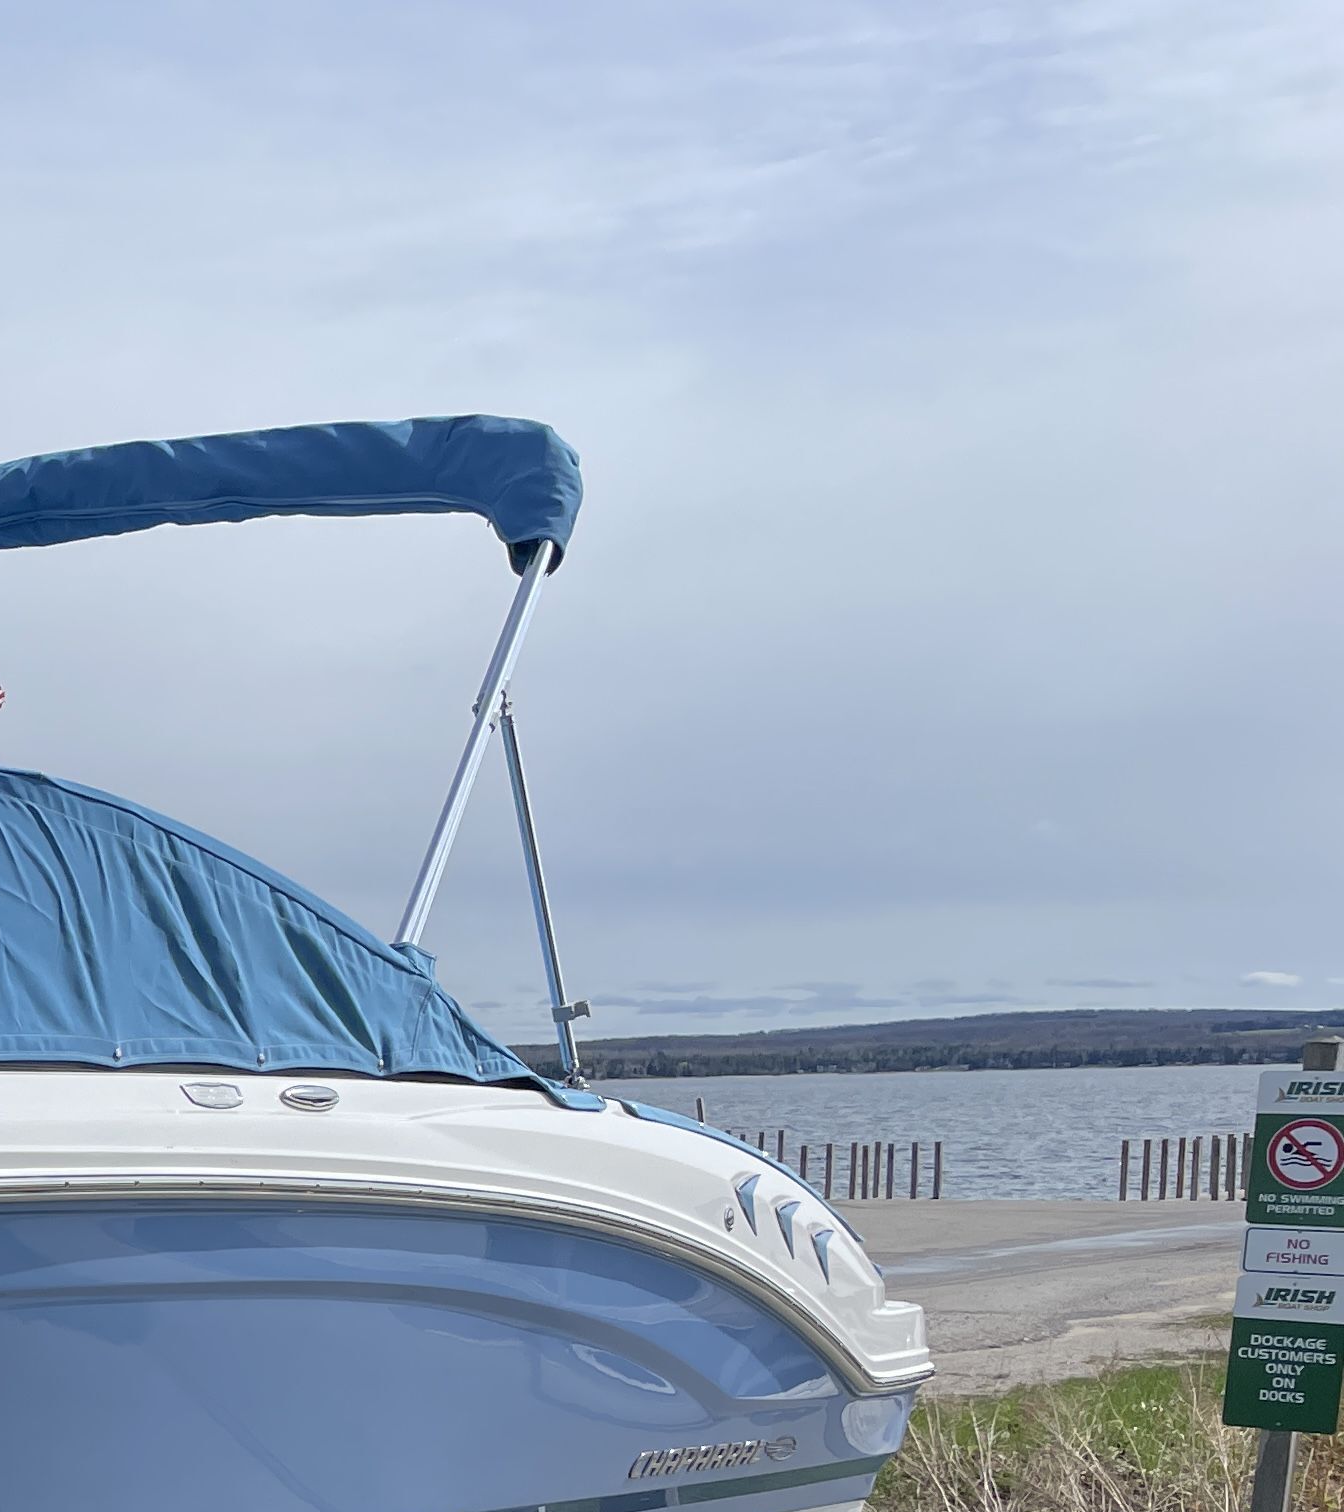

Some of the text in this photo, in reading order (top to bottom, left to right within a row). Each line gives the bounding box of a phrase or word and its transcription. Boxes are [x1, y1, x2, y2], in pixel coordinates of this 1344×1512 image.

[1258, 1193, 1344, 1206] NO SWIMMING
[1266, 1204, 1335, 1216] PERMITTED
[1287, 1239, 1311, 1250] NO
[1265, 1252, 1330, 1266] FISHING
[1264, 1287, 1337, 1305] IRISH
[1250, 1334, 1328, 1351] DOCKAGE
[1238, 1347, 1337, 1365] CUSTOMERS
[1265, 1363, 1305, 1376] ONLY
[1272, 1377, 1296, 1389] ON
[1259, 1389, 1305, 1404] DOCKS
[627, 1439, 766, 1480] CHAPARRAL
